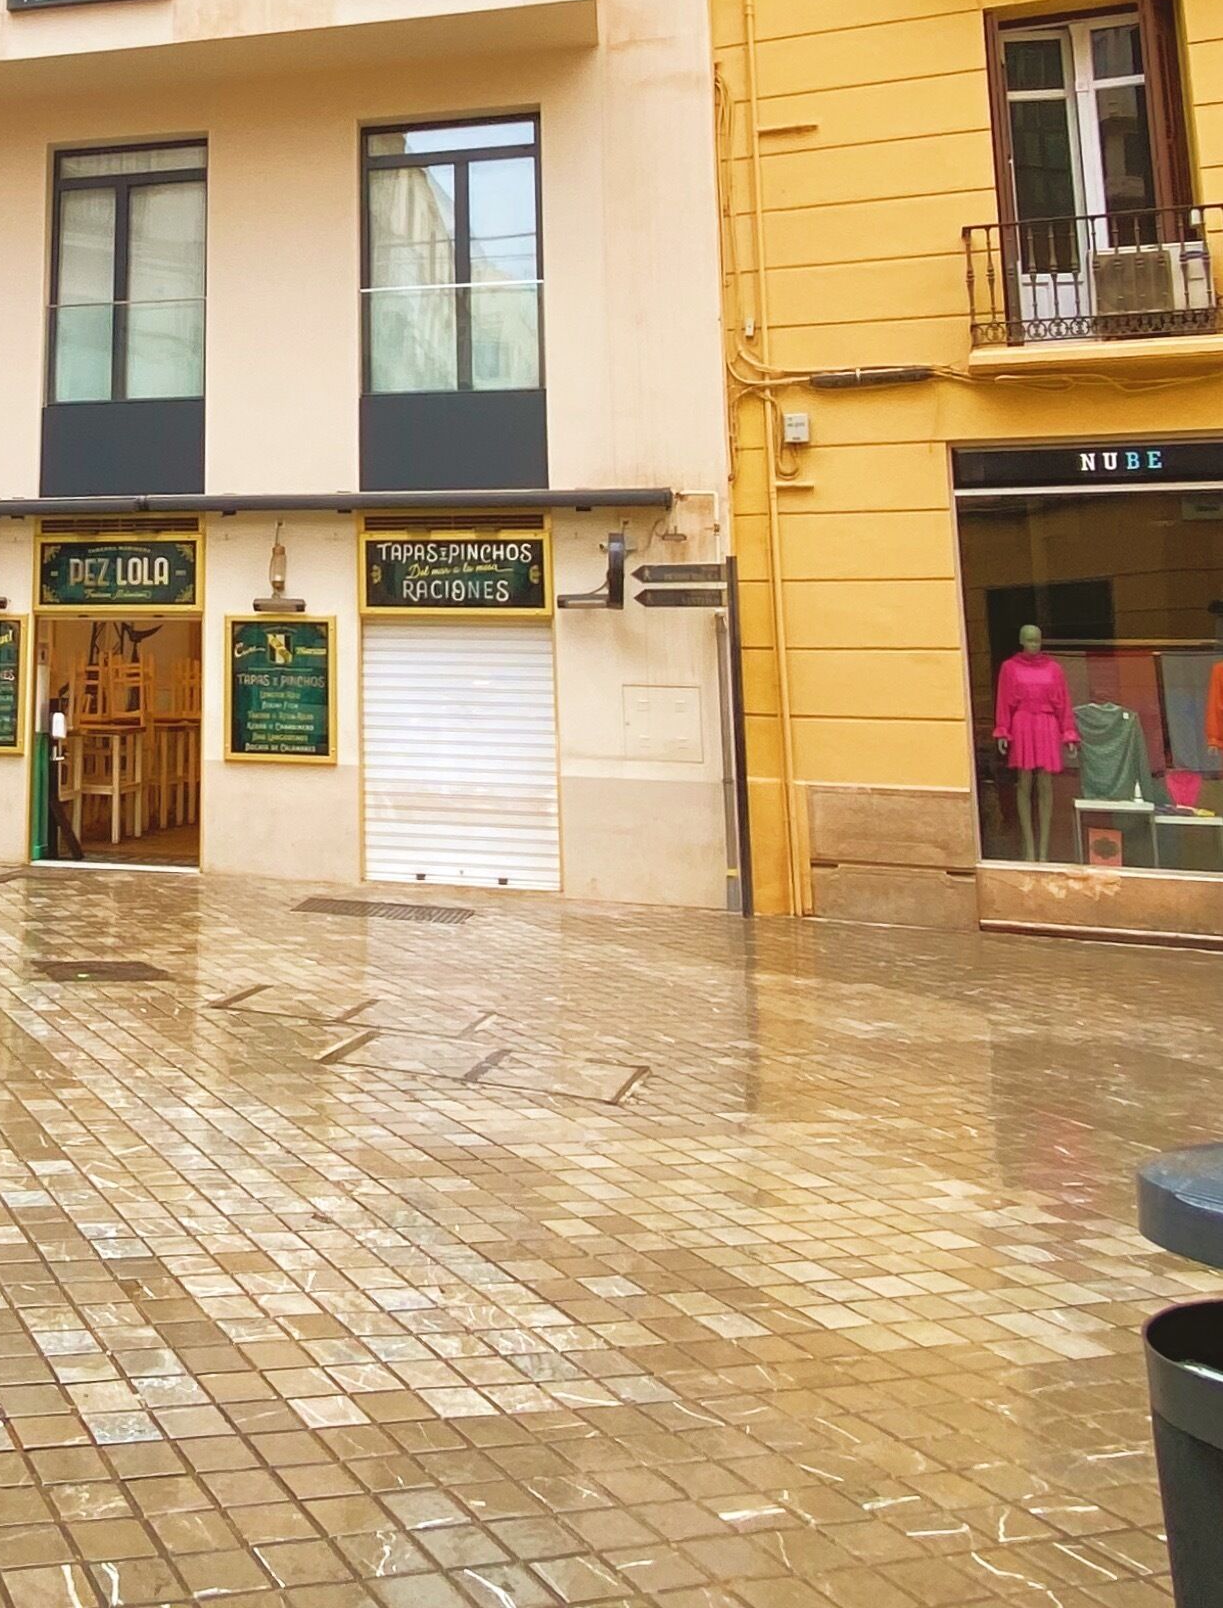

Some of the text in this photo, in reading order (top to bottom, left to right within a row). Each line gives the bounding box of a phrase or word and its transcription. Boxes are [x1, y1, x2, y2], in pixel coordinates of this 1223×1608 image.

[1080, 451, 1162, 471] NUBE
[377, 542, 438, 564] TAPAS
[448, 543, 532, 564] PINCHOS
[69, 556, 169, 586] PEZ LOLA
[403, 580, 509, 602] RACIONES
[237, 674, 270, 686] TAPAS
[280, 675, 325, 687] PINCHOS
